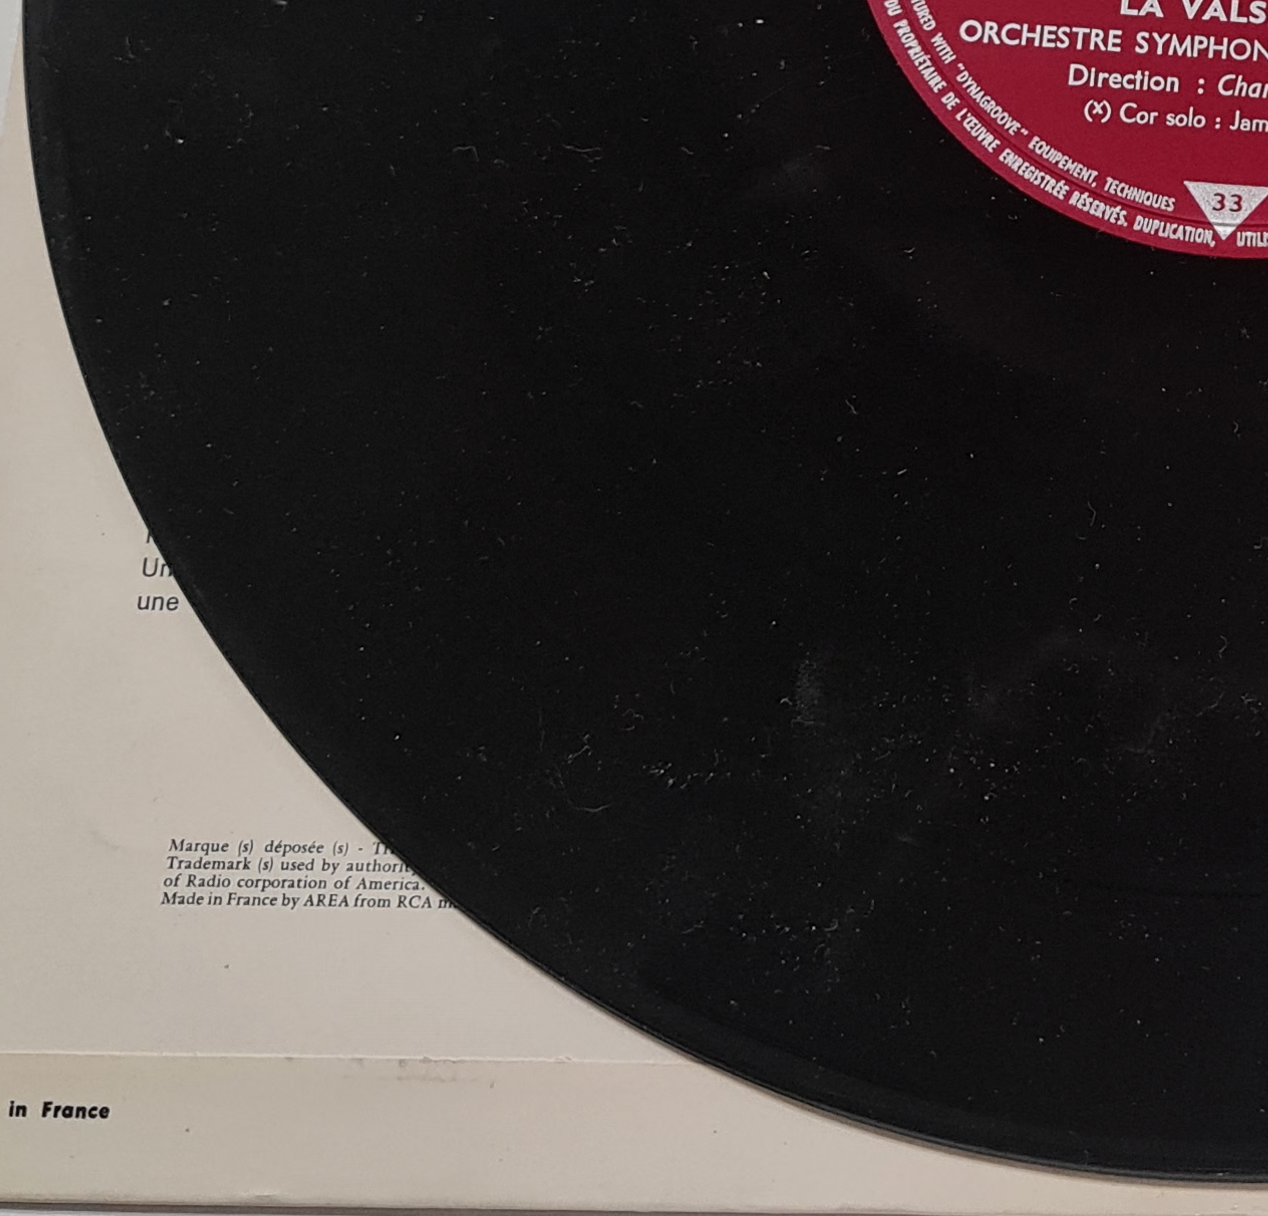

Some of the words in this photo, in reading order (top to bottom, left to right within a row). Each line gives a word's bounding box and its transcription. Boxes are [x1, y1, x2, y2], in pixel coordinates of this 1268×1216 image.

[958, 19, 1123, 53] ORCHESTRE
[1067, 63, 1180, 93] Direction
[931, 32, 957, 65] WITH
[1028, 135, 1099, 188] EQUIPEMENT,
[1103, 177, 1176, 212] TECHNIQUES
[1119, 102, 1159, 125] Cor
[1165, 106, 1206, 129] solo
[893, 19, 948, 94] PROPRIÉTAIRE
[941, 91, 961, 111] DE
[999, 148, 1070, 201] ENREGISTRÉE
[1133, 215, 1217, 248] DUPLICATION,
[1212, 192, 1243, 212] 33
[137, 595, 179, 611] une
[168, 838, 230, 857] Marque
[237, 839, 254, 858] (s)
[264, 839, 325, 858] déposée
[332, 840, 349, 857] (s)
[166, 855, 252, 871] Trademark
[257, 856, 274, 874] (s)
[280, 857, 316, 872] used
[321, 857, 341, 876] by
[163, 872, 183, 888] of
[185, 873, 231, 888] Radio
[236, 874, 327, 893] corporation
[333, 875, 353, 890] of
[355, 877, 426, 891] America.
[160, 891, 205, 906] Made
[207, 891, 223, 906] in
[226, 891, 278, 907] France
[281, 892, 301, 911] by
[302, 893, 350, 908] AREA
[353, 893, 391, 908] from
[396, 894, 433, 909] RCA
[8, 1099, 28, 1118] in
[41, 1100, 111, 1120] France
